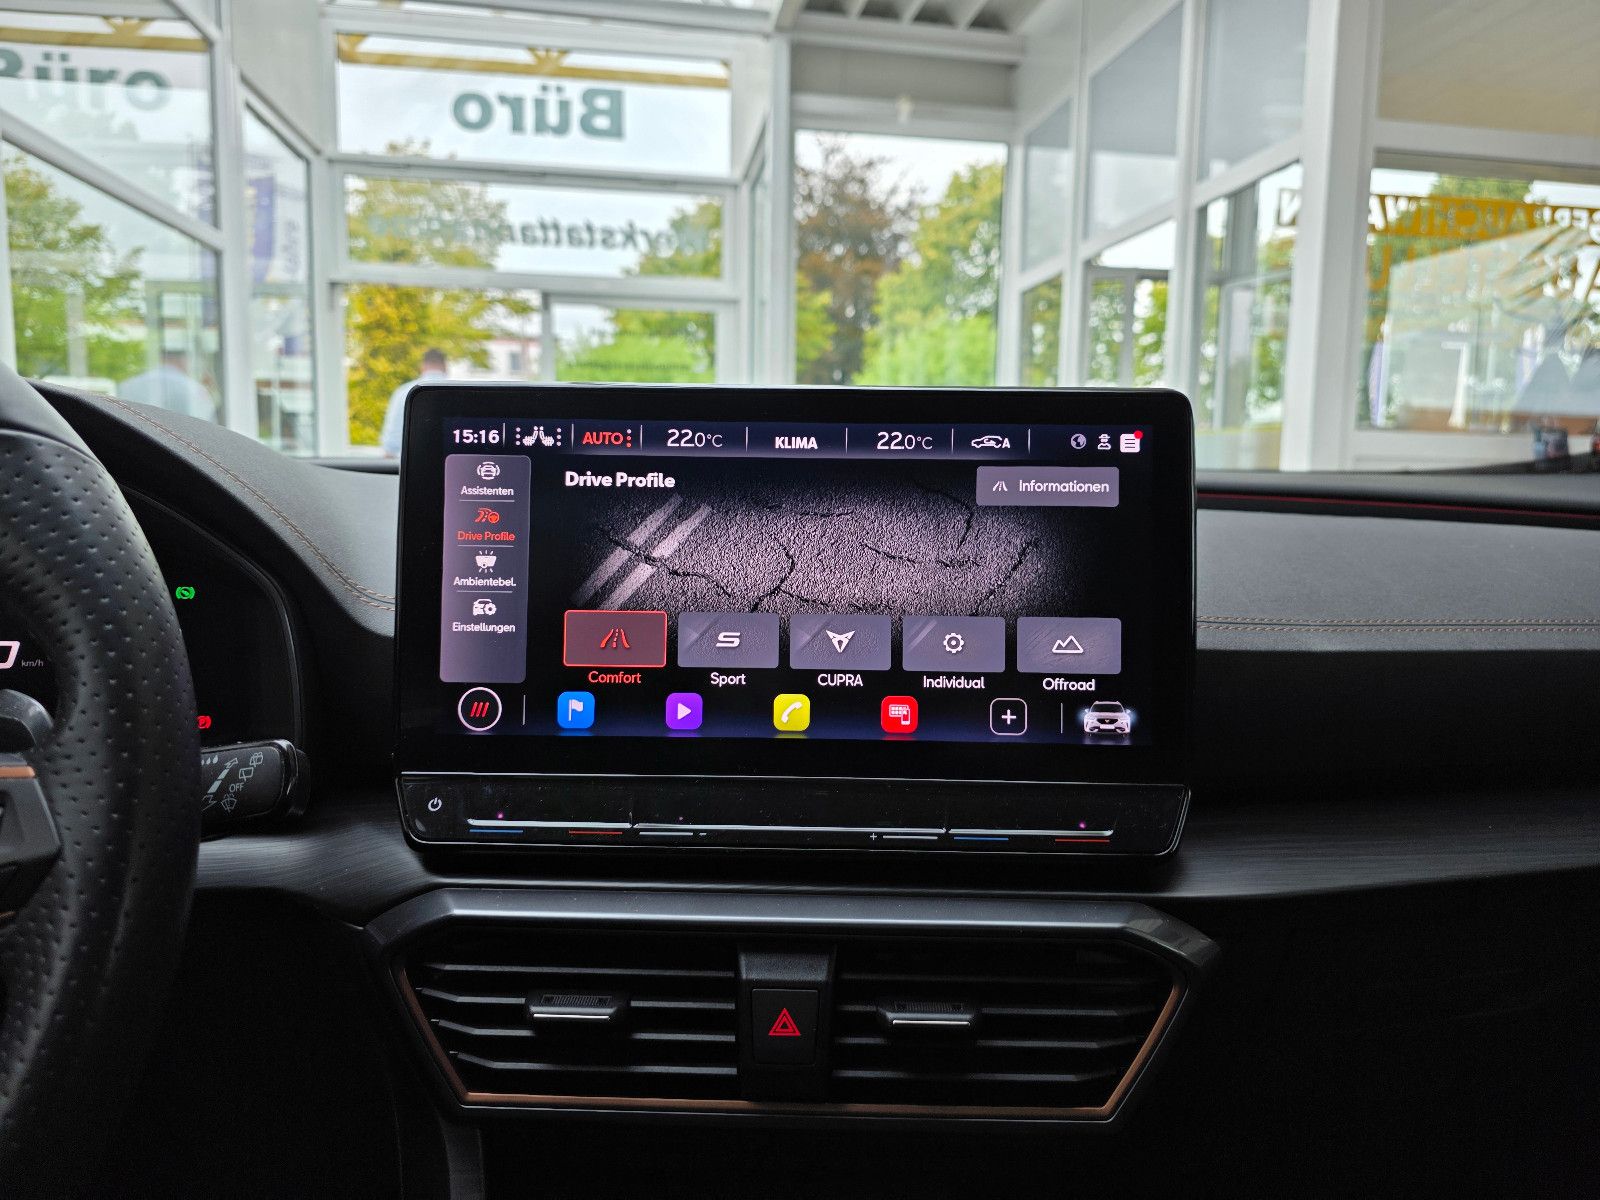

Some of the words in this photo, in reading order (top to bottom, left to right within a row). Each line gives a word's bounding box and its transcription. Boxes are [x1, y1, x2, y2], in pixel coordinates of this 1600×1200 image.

[453, 429, 500, 444] 15:16
[582, 432, 624, 445] AUTO
[775, 436, 818, 449] KLIMA
[1002, 437, 1011, 449] A
[565, 471, 612, 487] Drive
[616, 472, 676, 488] Profile
[460, 485, 514, 496] Assistenten
[1019, 479, 1110, 494] Informationen
[457, 530, 482, 541] Drive
[484, 531, 516, 541] Profile
[453, 576, 517, 588] Ambientebel.
[452, 622, 516, 634] Einstellungen
[21, 659, 44, 668] km/h
[588, 670, 642, 684] Comfort
[710, 672, 746, 687] Sport
[817, 673, 864, 687] CUPRA
[923, 675, 985, 690] Individual
[1042, 677, 1096, 692] Offroad
[228, 782, 245, 793] OFF
